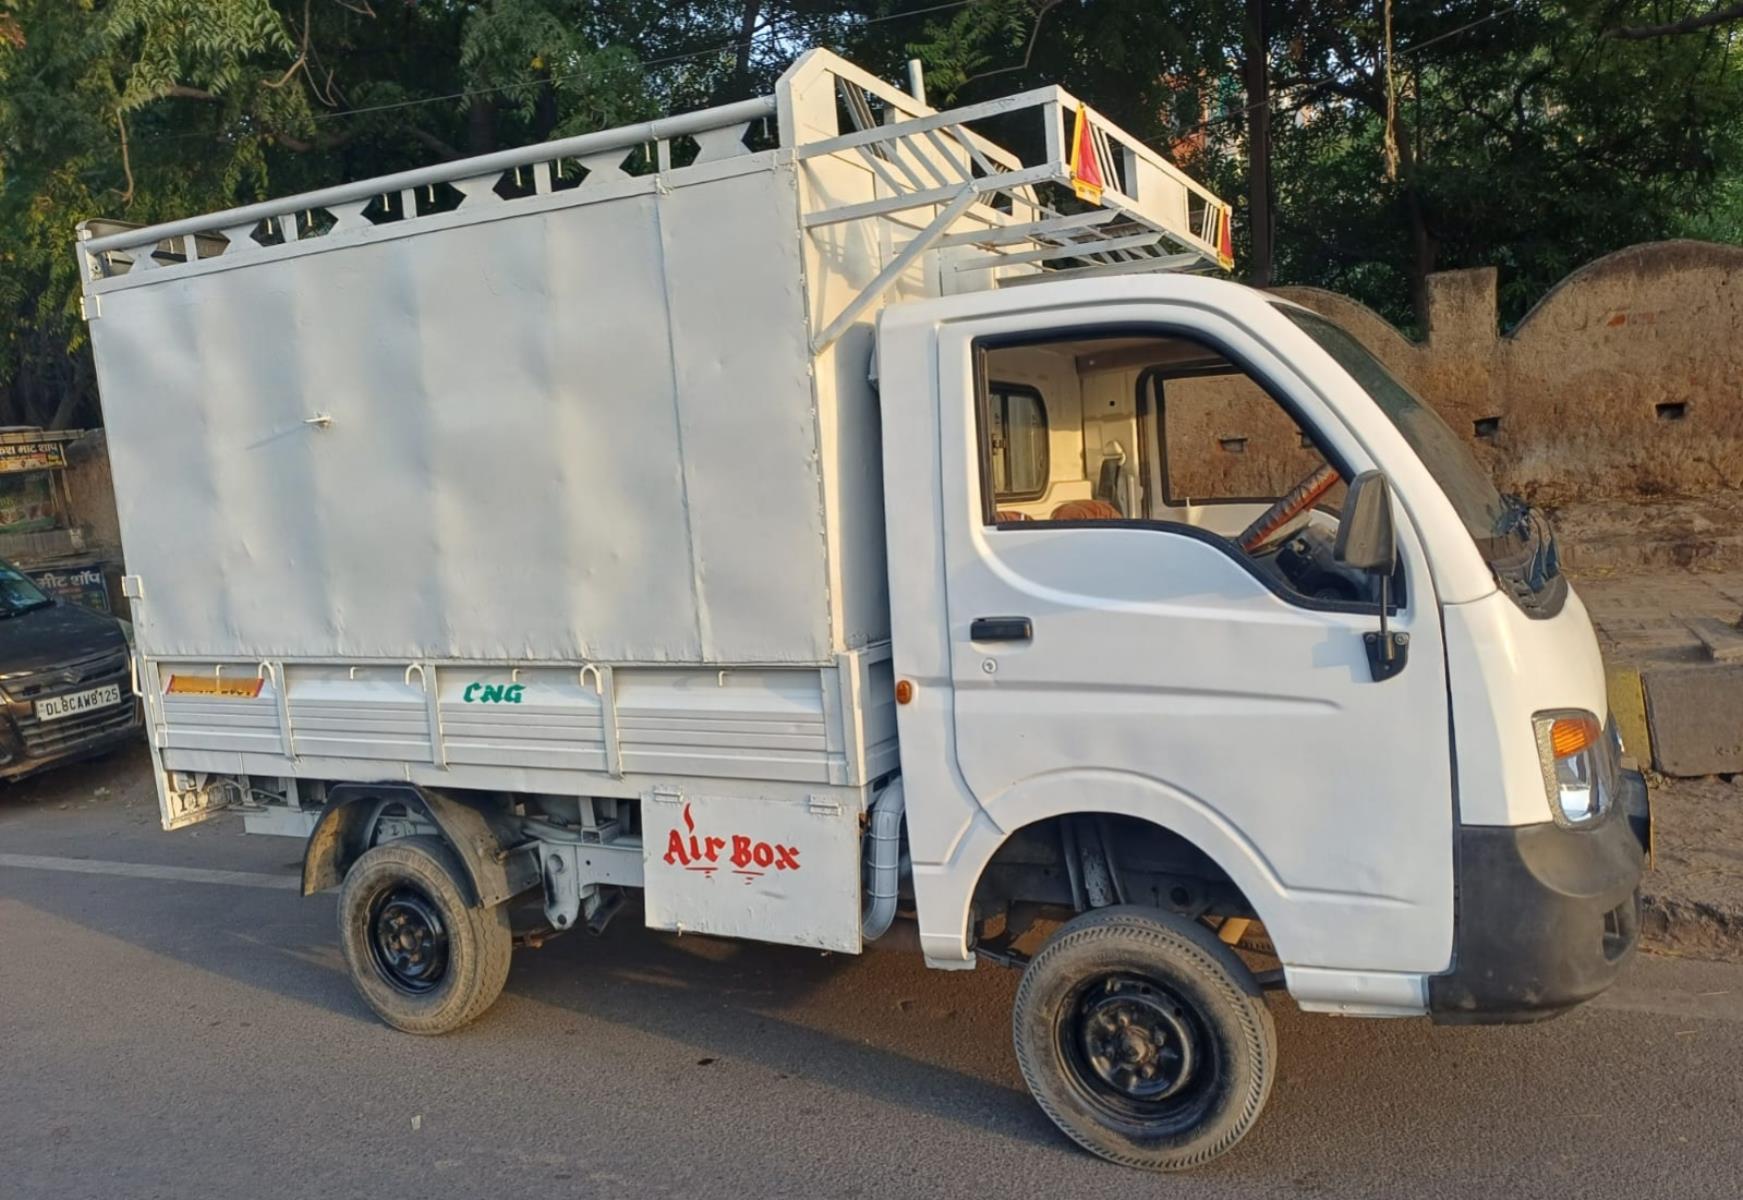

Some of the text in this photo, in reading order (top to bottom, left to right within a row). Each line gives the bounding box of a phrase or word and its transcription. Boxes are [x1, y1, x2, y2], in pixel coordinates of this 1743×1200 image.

[70, 570, 101, 586] शॉप
[463, 682, 526, 703] CNG
[663, 802, 726, 866] Air
